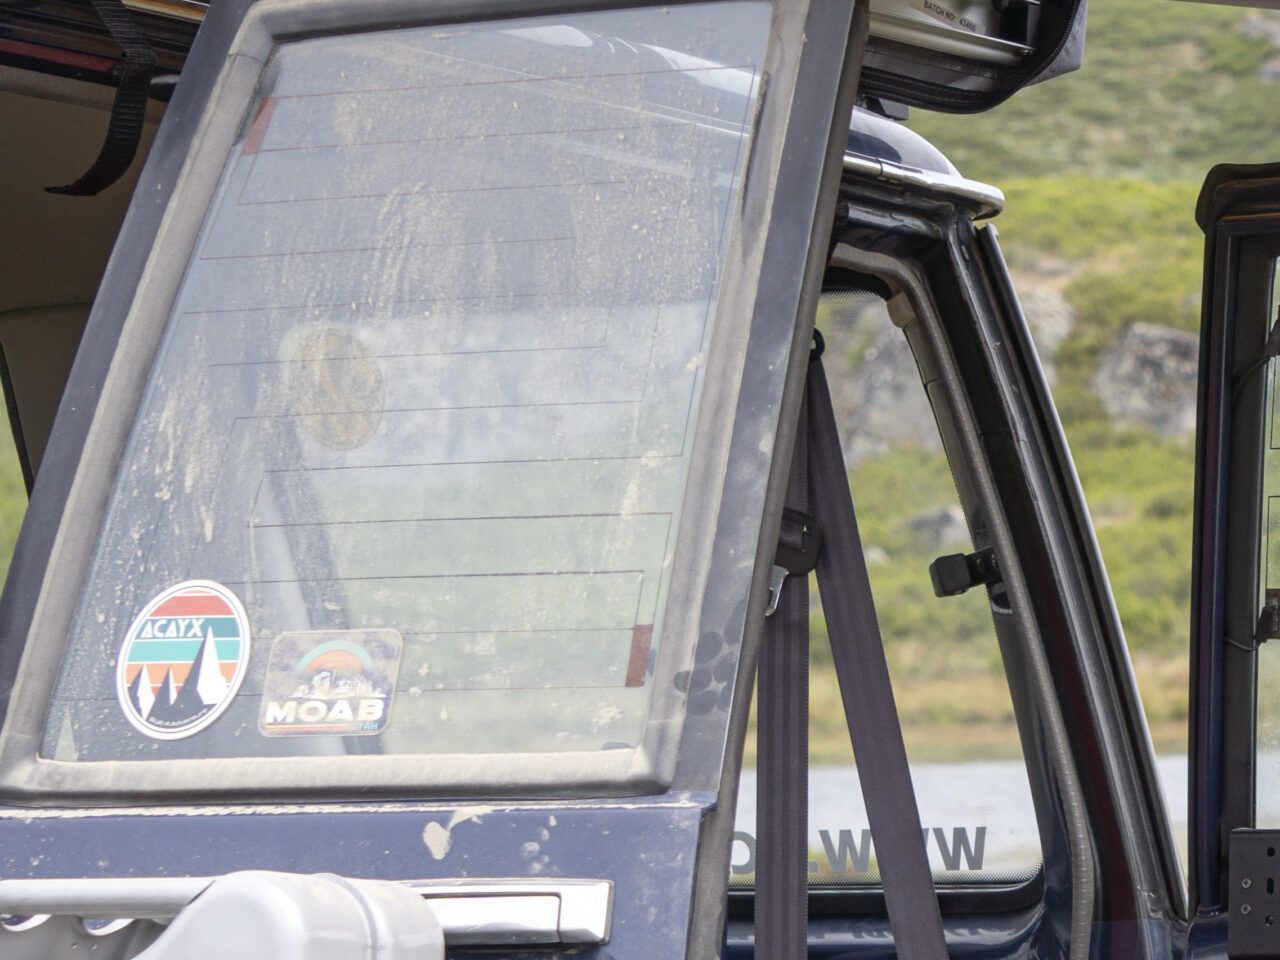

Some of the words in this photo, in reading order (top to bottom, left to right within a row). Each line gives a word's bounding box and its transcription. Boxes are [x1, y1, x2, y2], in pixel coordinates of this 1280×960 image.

[923, 0, 945, 16] BATCH
[140, 618, 205, 639] ACAYX
[266, 698, 385, 724] MOAB
